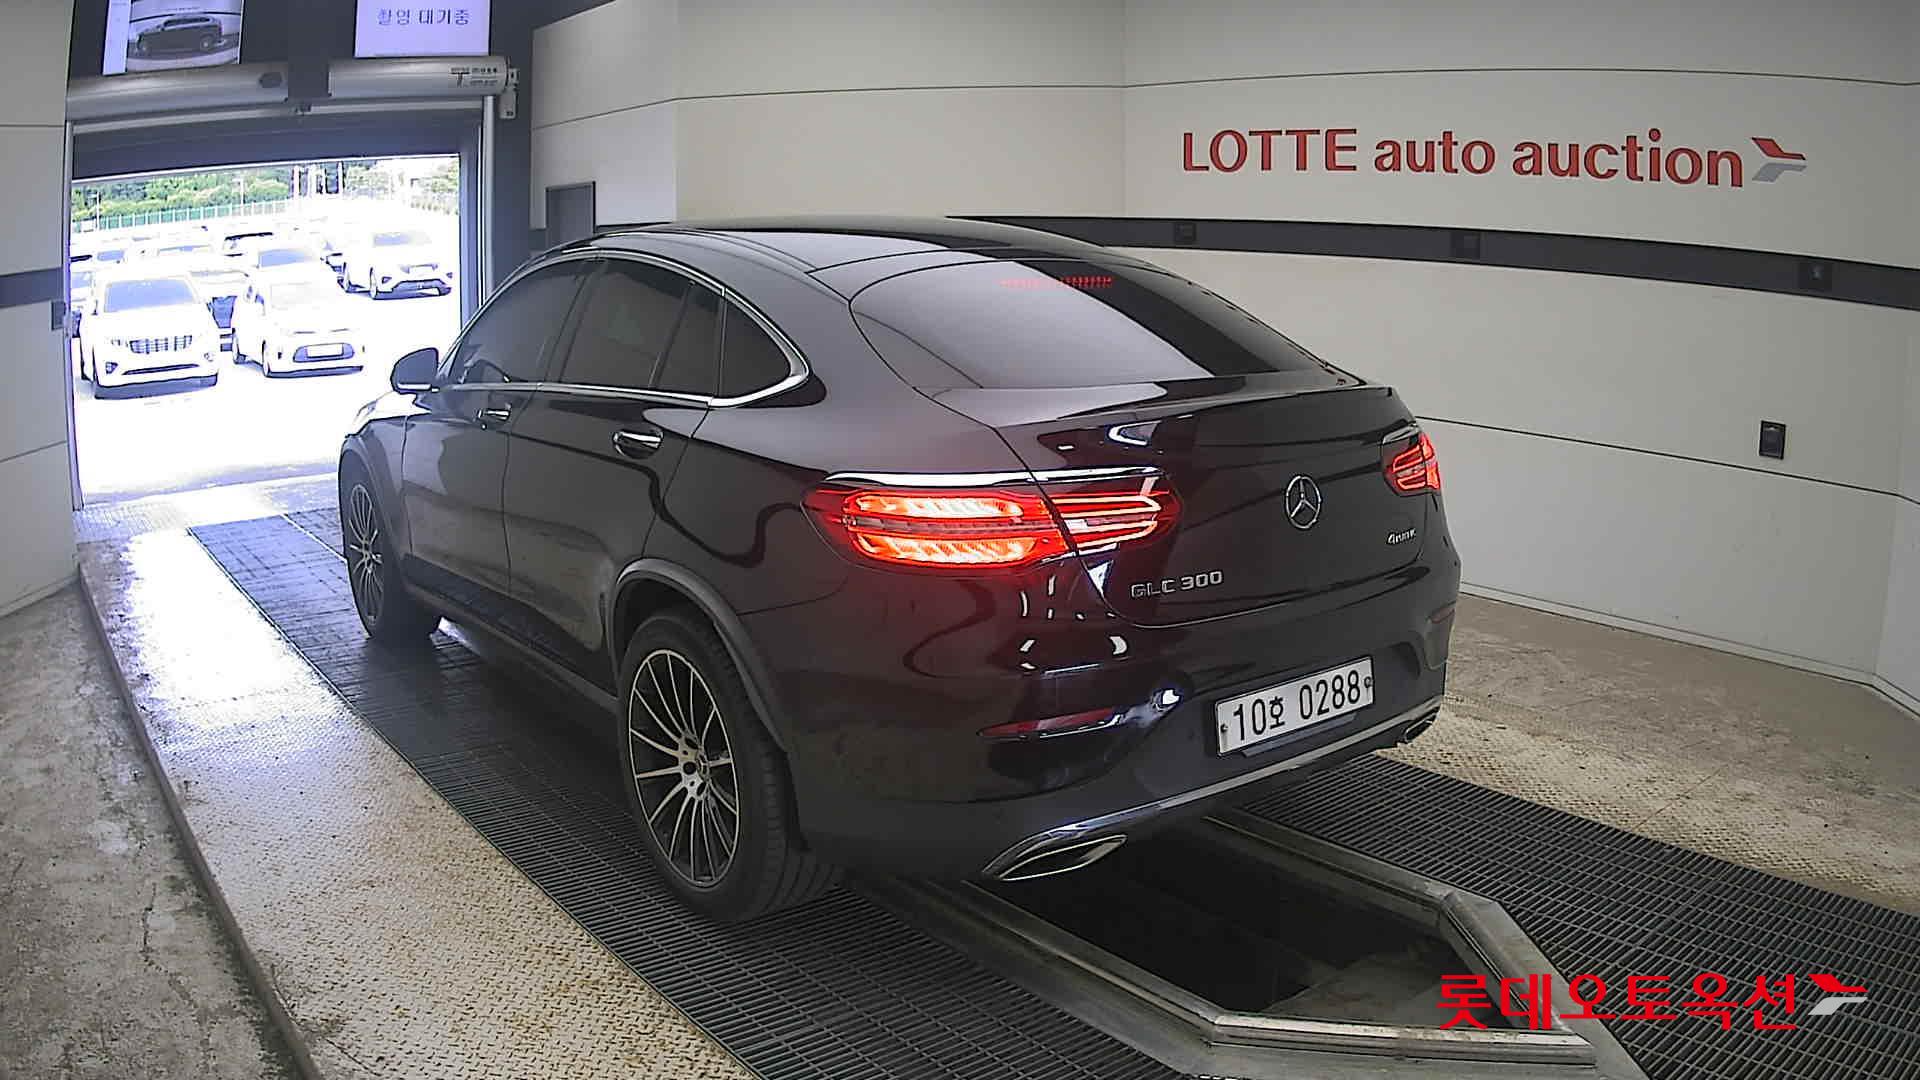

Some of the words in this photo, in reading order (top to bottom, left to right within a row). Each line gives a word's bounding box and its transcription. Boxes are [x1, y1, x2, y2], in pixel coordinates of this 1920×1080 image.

[419, 8, 470, 25] 대기중
[1183, 128, 1357, 172] LOTTE
[1374, 130, 1496, 174] auto
[1512, 128, 1743, 187] auction
[1130, 579, 1177, 598] GLC
[1180, 570, 1223, 590] 300
[1233, 696, 1285, 741] 10호
[1300, 670, 1360, 720] 0288
